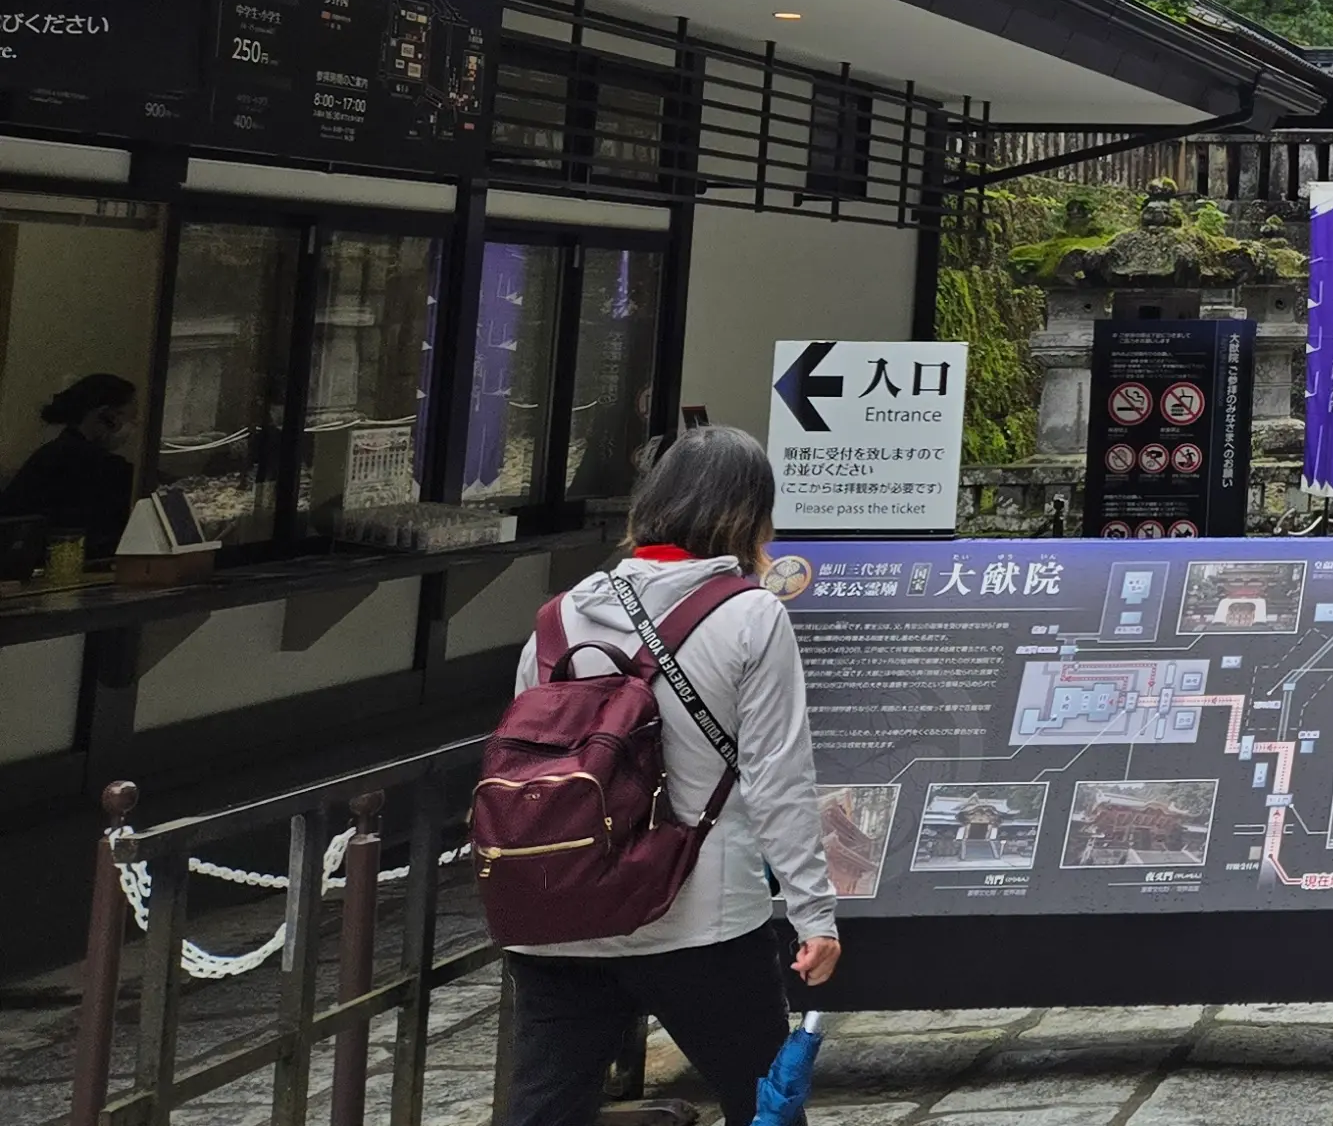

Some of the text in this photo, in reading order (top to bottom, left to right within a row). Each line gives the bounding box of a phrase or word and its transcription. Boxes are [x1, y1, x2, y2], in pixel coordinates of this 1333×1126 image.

[0, 13, 109, 34] びください
[858, 357, 951, 399] 入口
[865, 407, 942, 422] Entrance
[784, 447, 945, 461] 順番に受付を致しますので
[783, 463, 874, 476] お並びください
[795, 502, 926, 516] Please pass the ticket
[933, 561, 1065, 596] 大猷院
[638, 619, 665, 655] YOUNG
[658, 655, 696, 703] FOREVER
[693, 710, 725, 750] YOUNG
